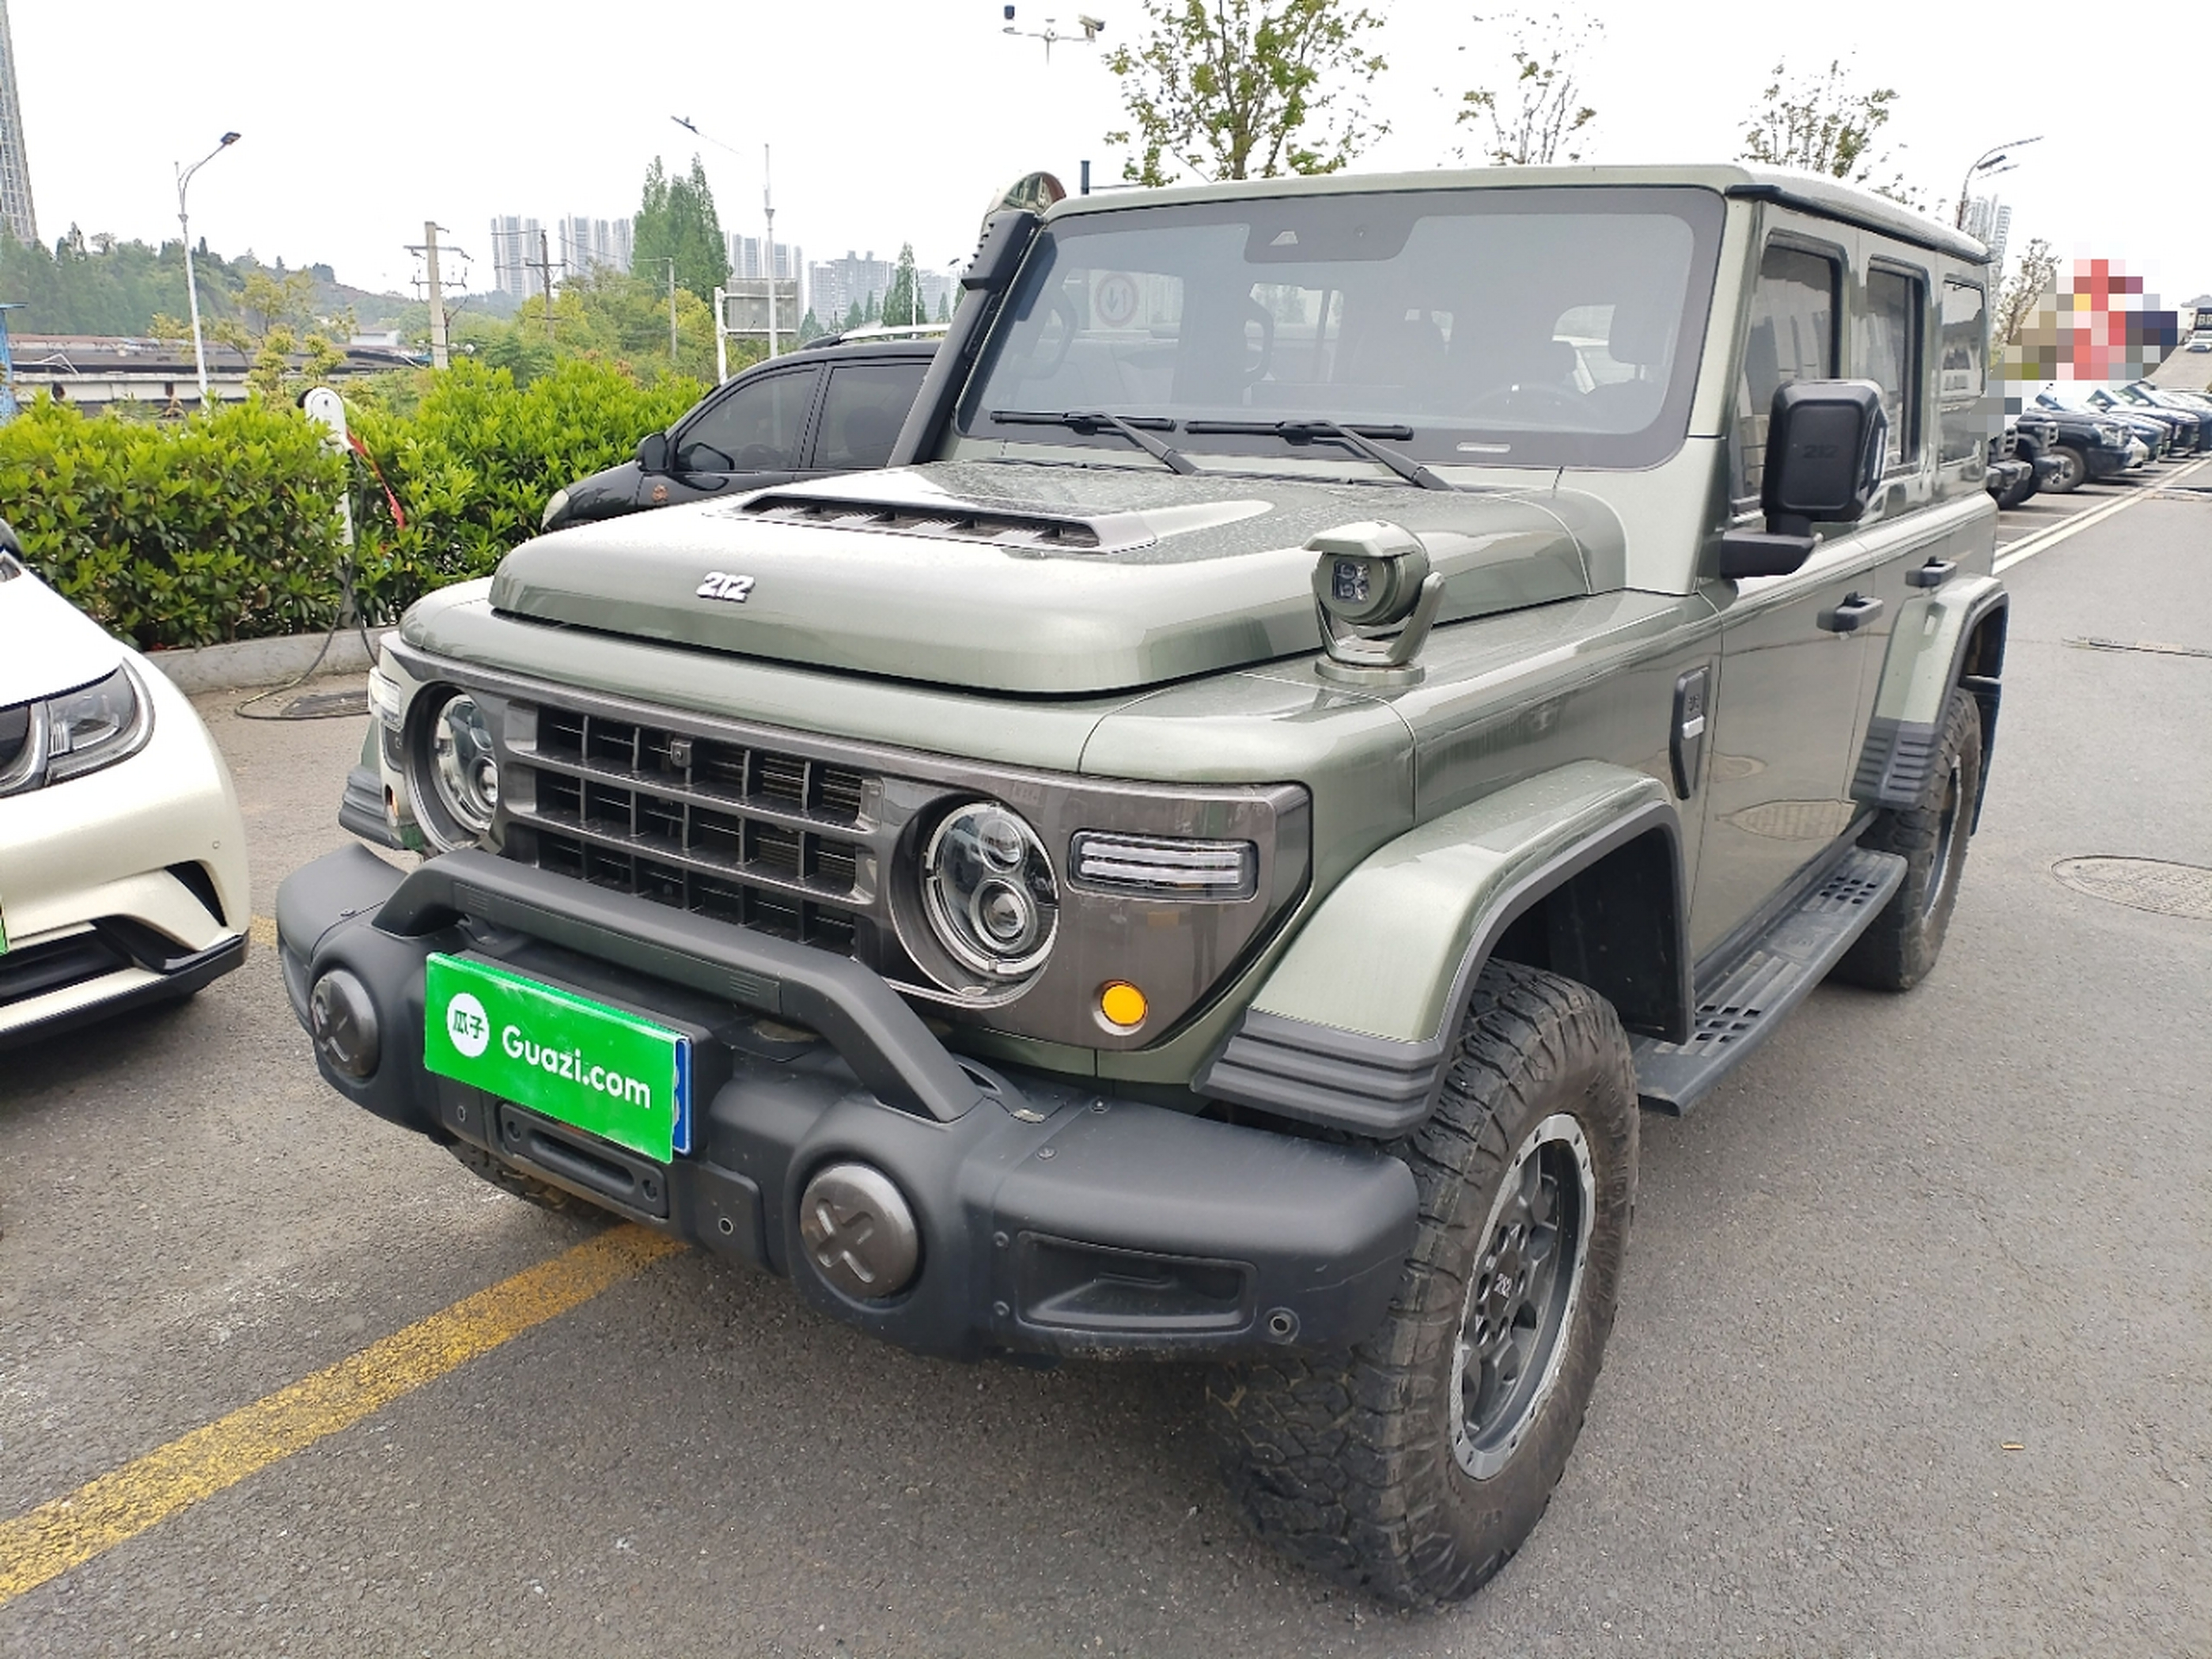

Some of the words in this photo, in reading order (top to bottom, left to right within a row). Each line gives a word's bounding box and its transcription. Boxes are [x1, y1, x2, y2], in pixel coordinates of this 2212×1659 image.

[1803, 445, 1839, 459] 212
[695, 570, 755, 603] 212
[453, 1009, 484, 1039] 瓜子
[502, 1025, 650, 1109] Guazi.com
